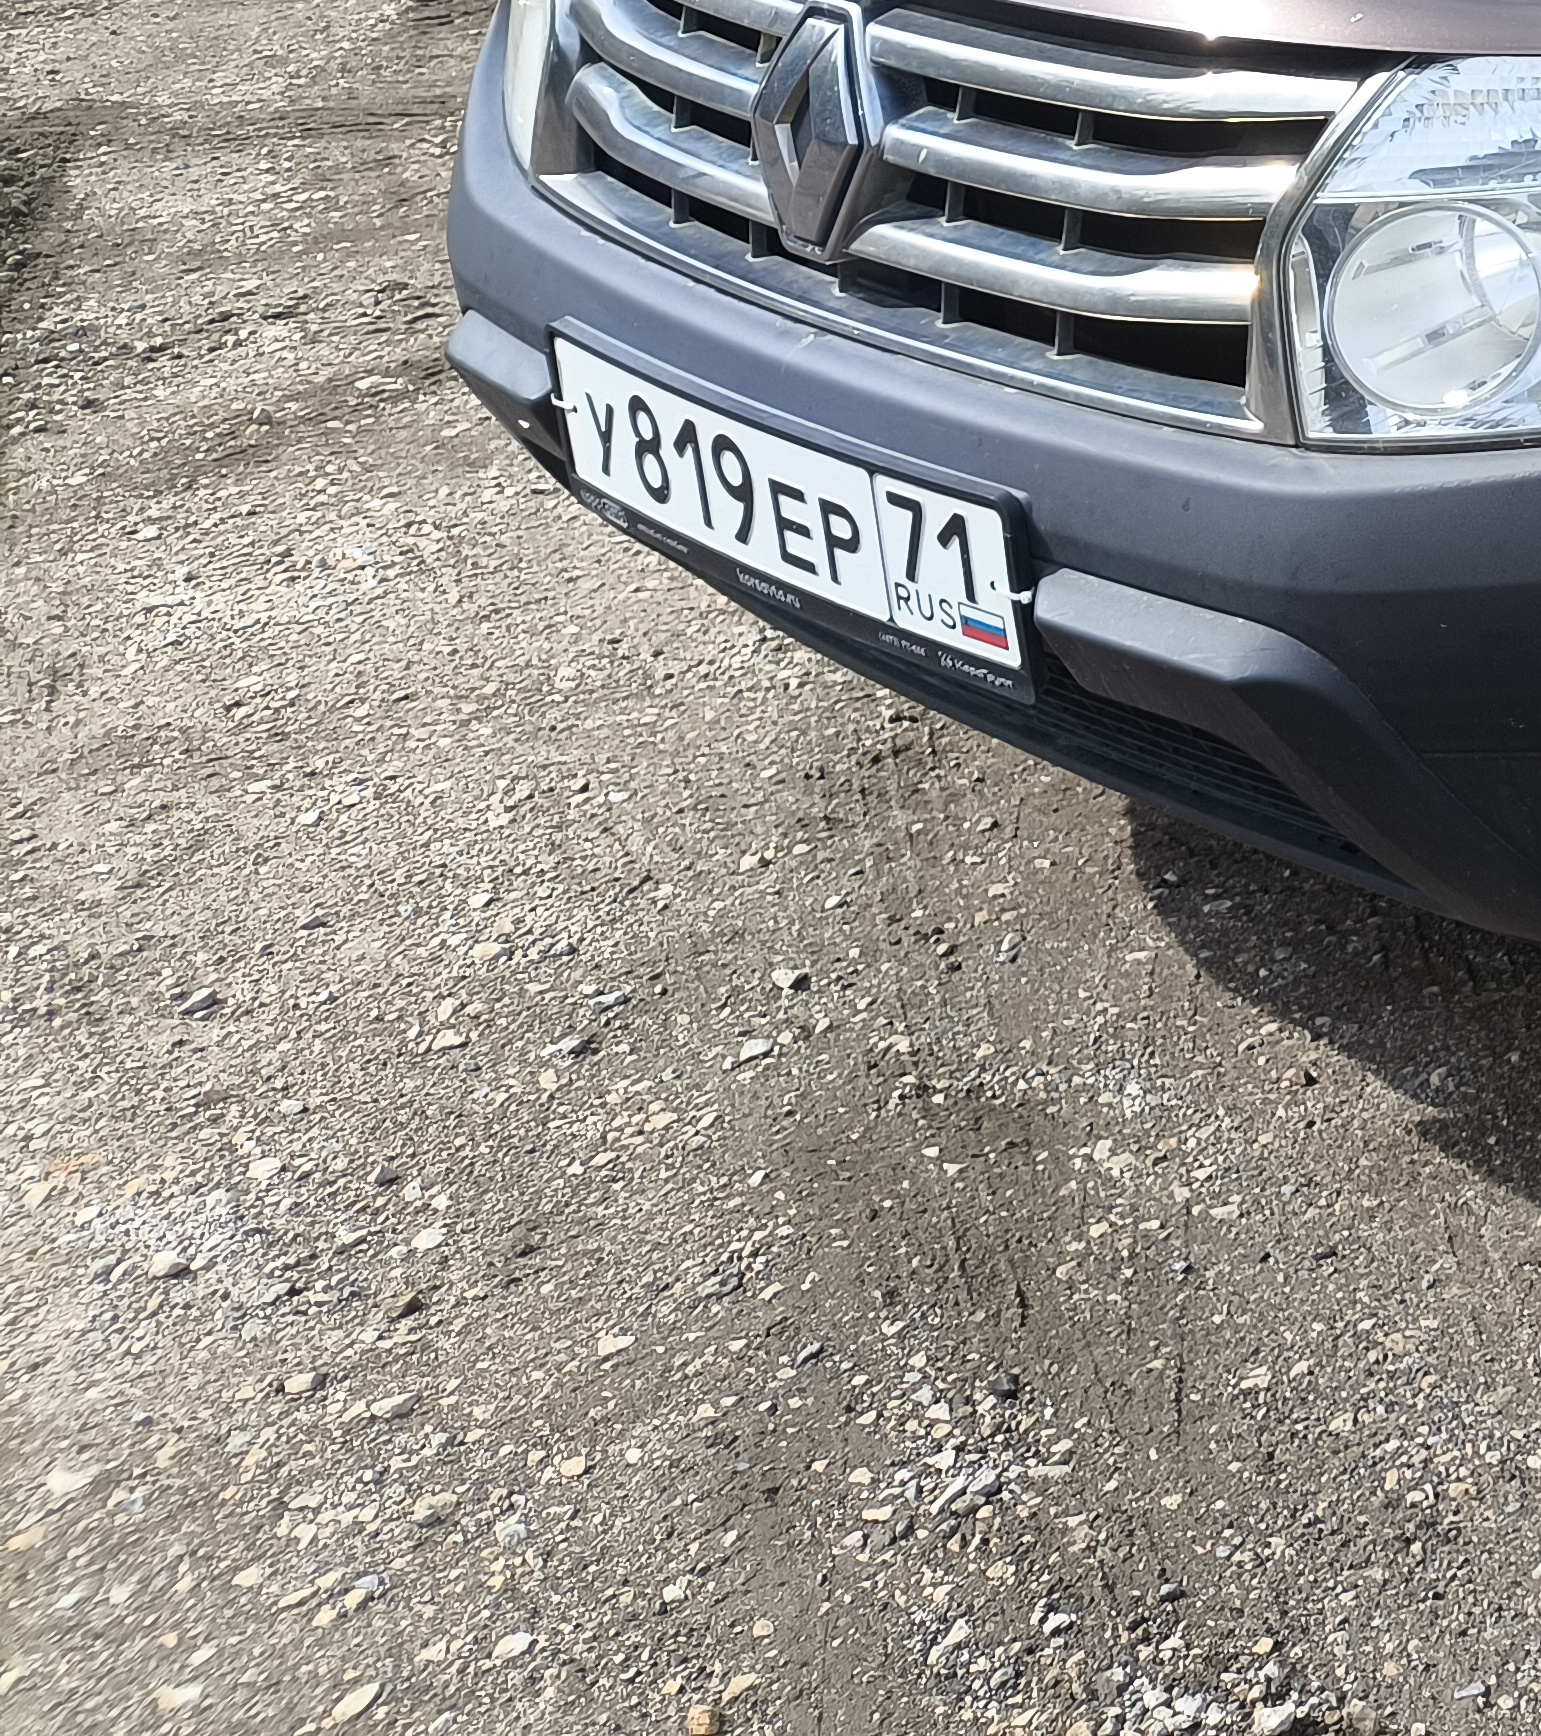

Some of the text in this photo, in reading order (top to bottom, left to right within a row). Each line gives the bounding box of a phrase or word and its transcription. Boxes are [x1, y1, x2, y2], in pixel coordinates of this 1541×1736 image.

[584, 391, 978, 605] У819ЕР 71
[894, 581, 957, 630] RUS
